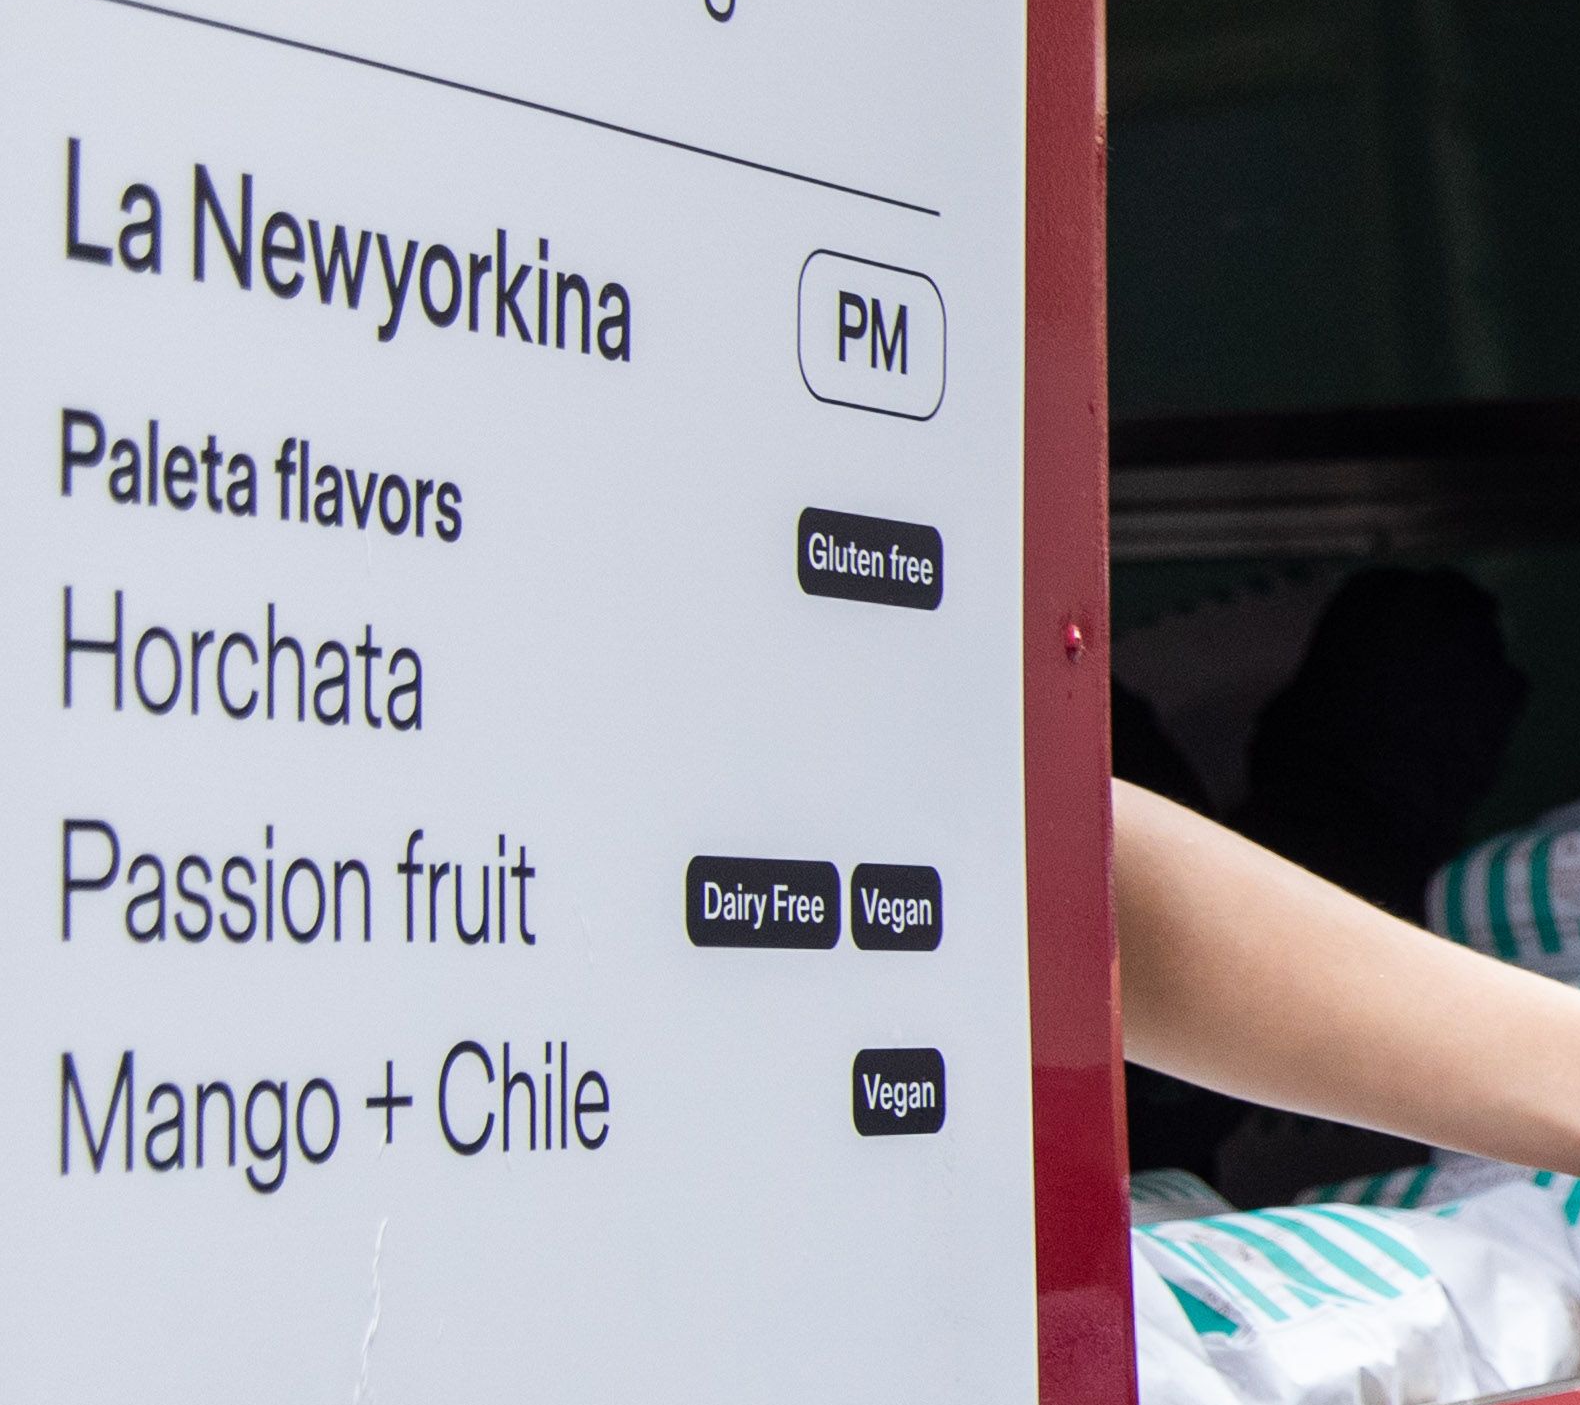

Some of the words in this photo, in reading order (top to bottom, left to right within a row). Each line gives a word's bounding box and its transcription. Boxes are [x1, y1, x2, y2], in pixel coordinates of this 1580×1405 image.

[64, 136, 163, 276] La
[192, 161, 634, 365] Newyorkina
[837, 289, 909, 377] PM
[59, 406, 259, 518] Paleta
[273, 435, 464, 545] flavors
[807, 531, 885, 580] Gluten
[889, 543, 934, 587] free
[61, 584, 424, 733] Horchata
[60, 817, 373, 946] Passion
[395, 827, 538, 948] fruit
[703, 880, 767, 931] Dairy
[772, 883, 826, 925] Free
[860, 886, 933, 934] Vegan
[59, 1048, 342, 1197] Mango
[364, 1058, 415, 1147] +
[437, 1038, 611, 1156] Chile
[862, 1072, 936, 1118] Vegan
